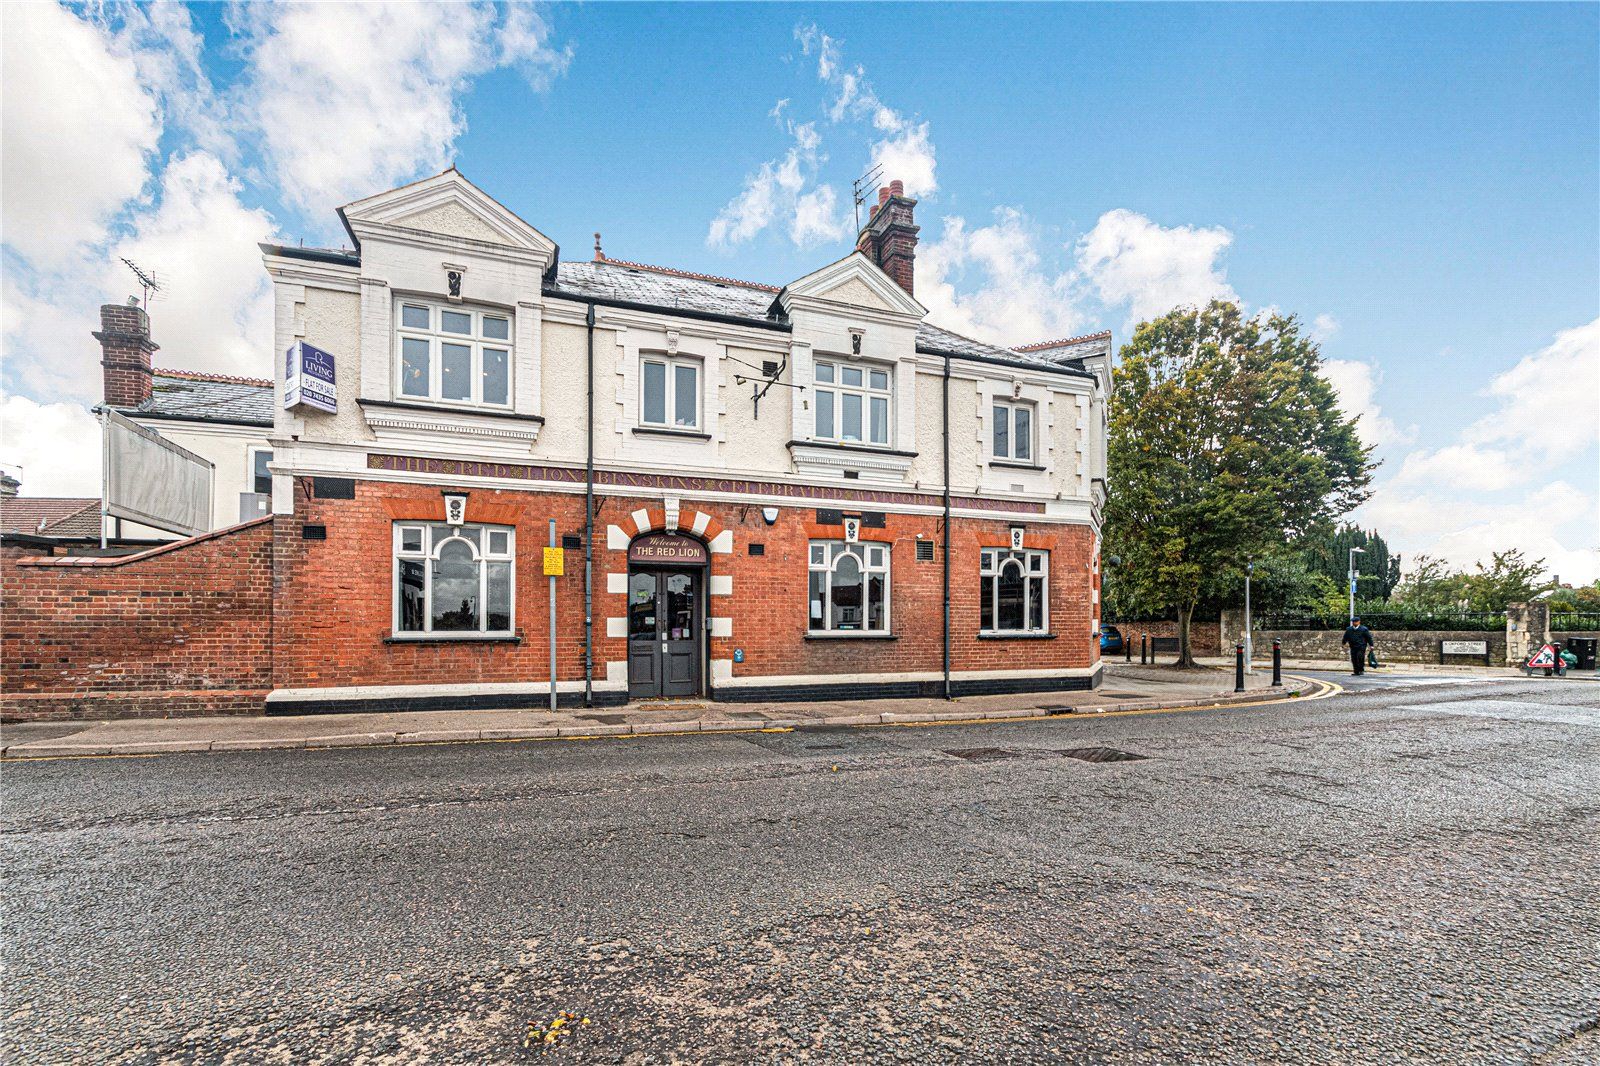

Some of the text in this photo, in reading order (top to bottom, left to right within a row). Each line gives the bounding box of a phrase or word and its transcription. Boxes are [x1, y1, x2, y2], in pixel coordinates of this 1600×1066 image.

[305, 360, 333, 378] LIVING
[304, 378, 334, 396] FLAT FOR SALE
[385, 456, 438, 473] THE
[460, 462, 506, 477] RED
[527, 467, 580, 482] LION
[597, 471, 702, 490] BENSKINS
[718, 480, 843, 500] CELEBRATED
[855, 489, 933, 505] WATFORD
[649, 536, 681, 547] Welcome
[636, 546, 700, 557] THE RED LION
